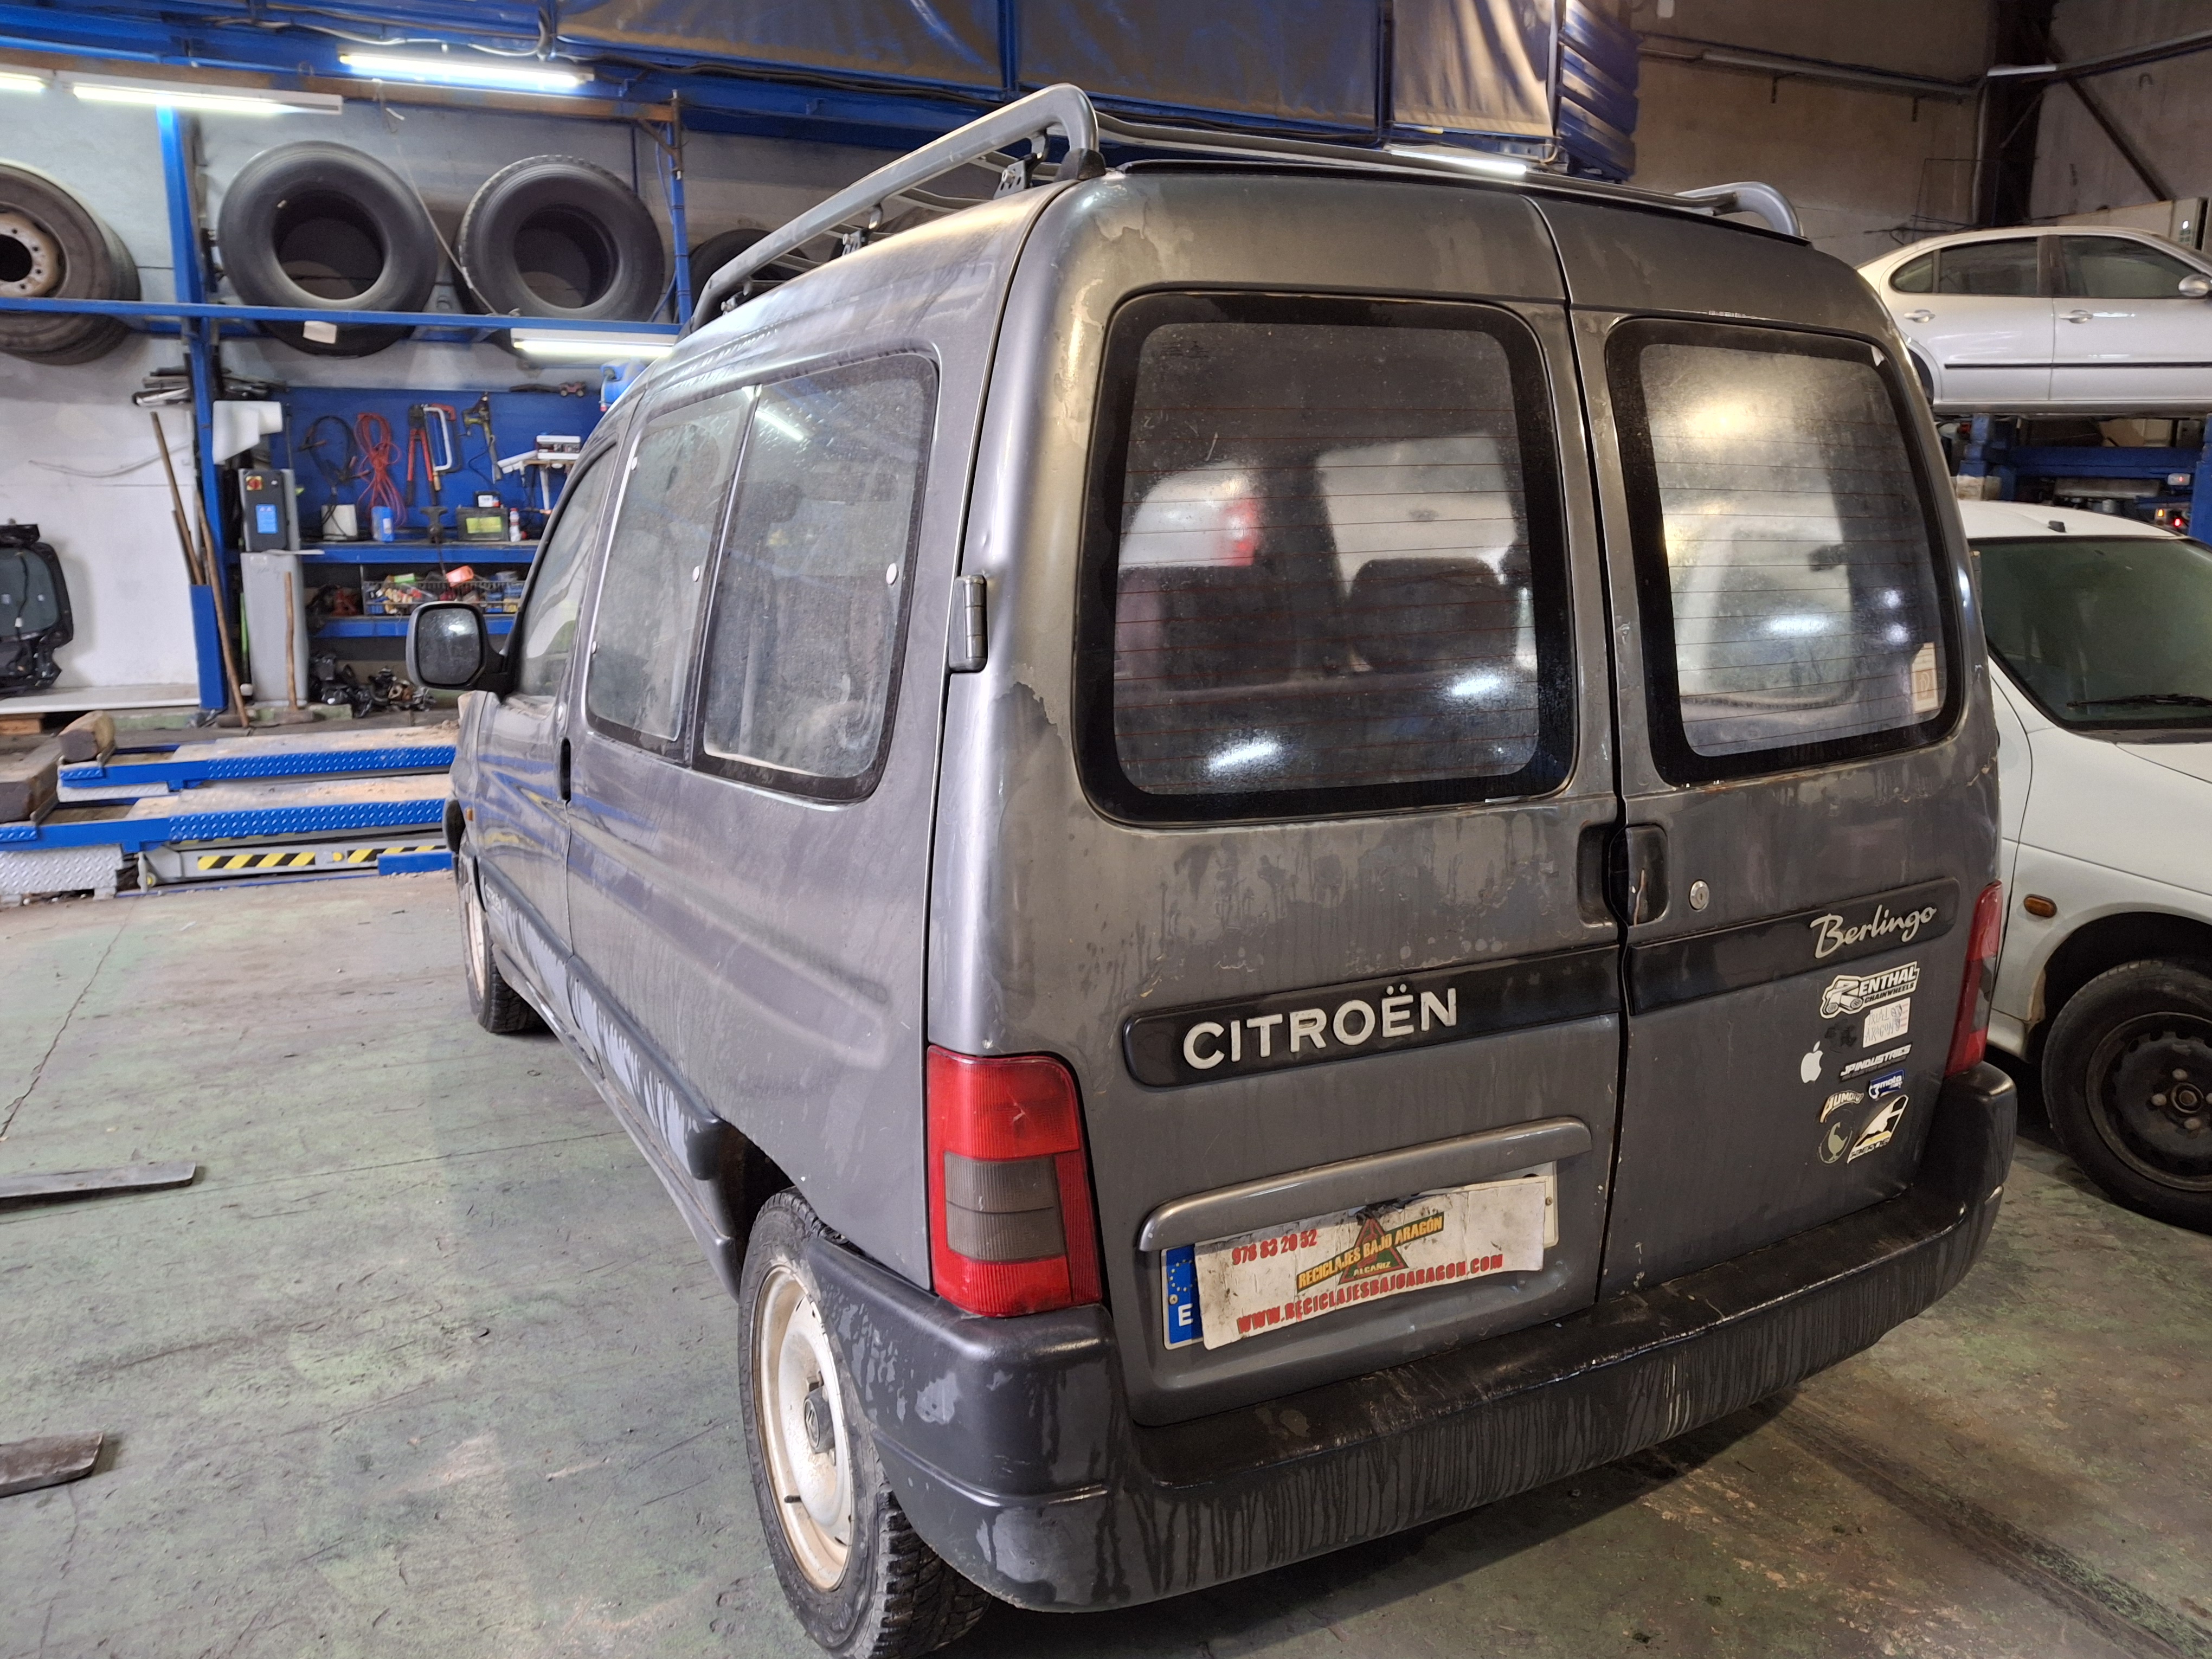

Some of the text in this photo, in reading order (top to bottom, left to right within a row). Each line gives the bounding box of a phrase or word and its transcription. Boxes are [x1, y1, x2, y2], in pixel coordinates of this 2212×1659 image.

[1810, 904, 1937, 959] Berlingo
[1864, 982, 1914, 1004] CHAINWHEELS
[1184, 983, 1457, 1069] CITROËN
[1232, 1244, 1257, 1265] 978
[1300, 1229, 1317, 1248] 52
[1298, 1246, 1361, 1289] RECICLAJES
[1363, 1233, 1392, 1258] BAJO
[1178, 1303, 1194, 1327] E
